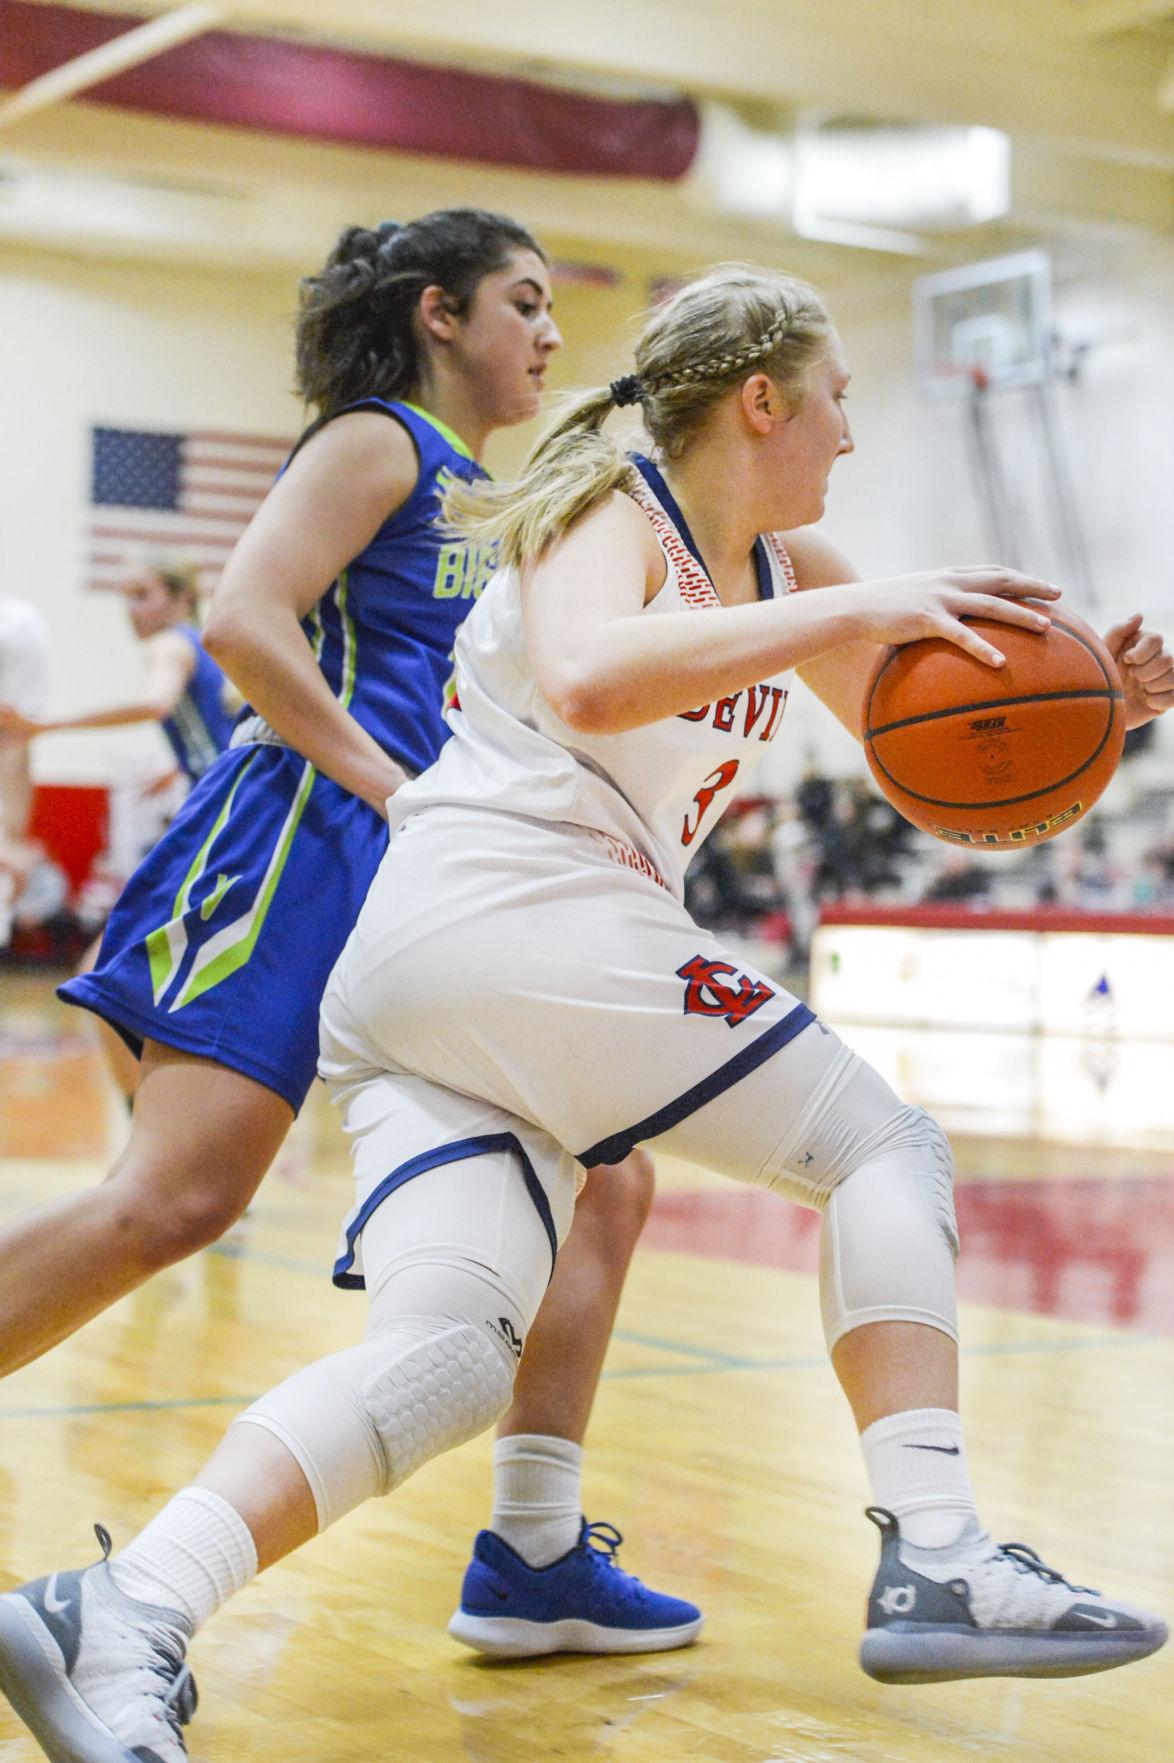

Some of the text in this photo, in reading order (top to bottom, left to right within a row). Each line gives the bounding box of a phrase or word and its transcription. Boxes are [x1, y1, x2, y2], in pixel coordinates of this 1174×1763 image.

[676, 684, 789, 742] EVI
[681, 759, 740, 847] 3
[935, 801, 1082, 844] ELITE
